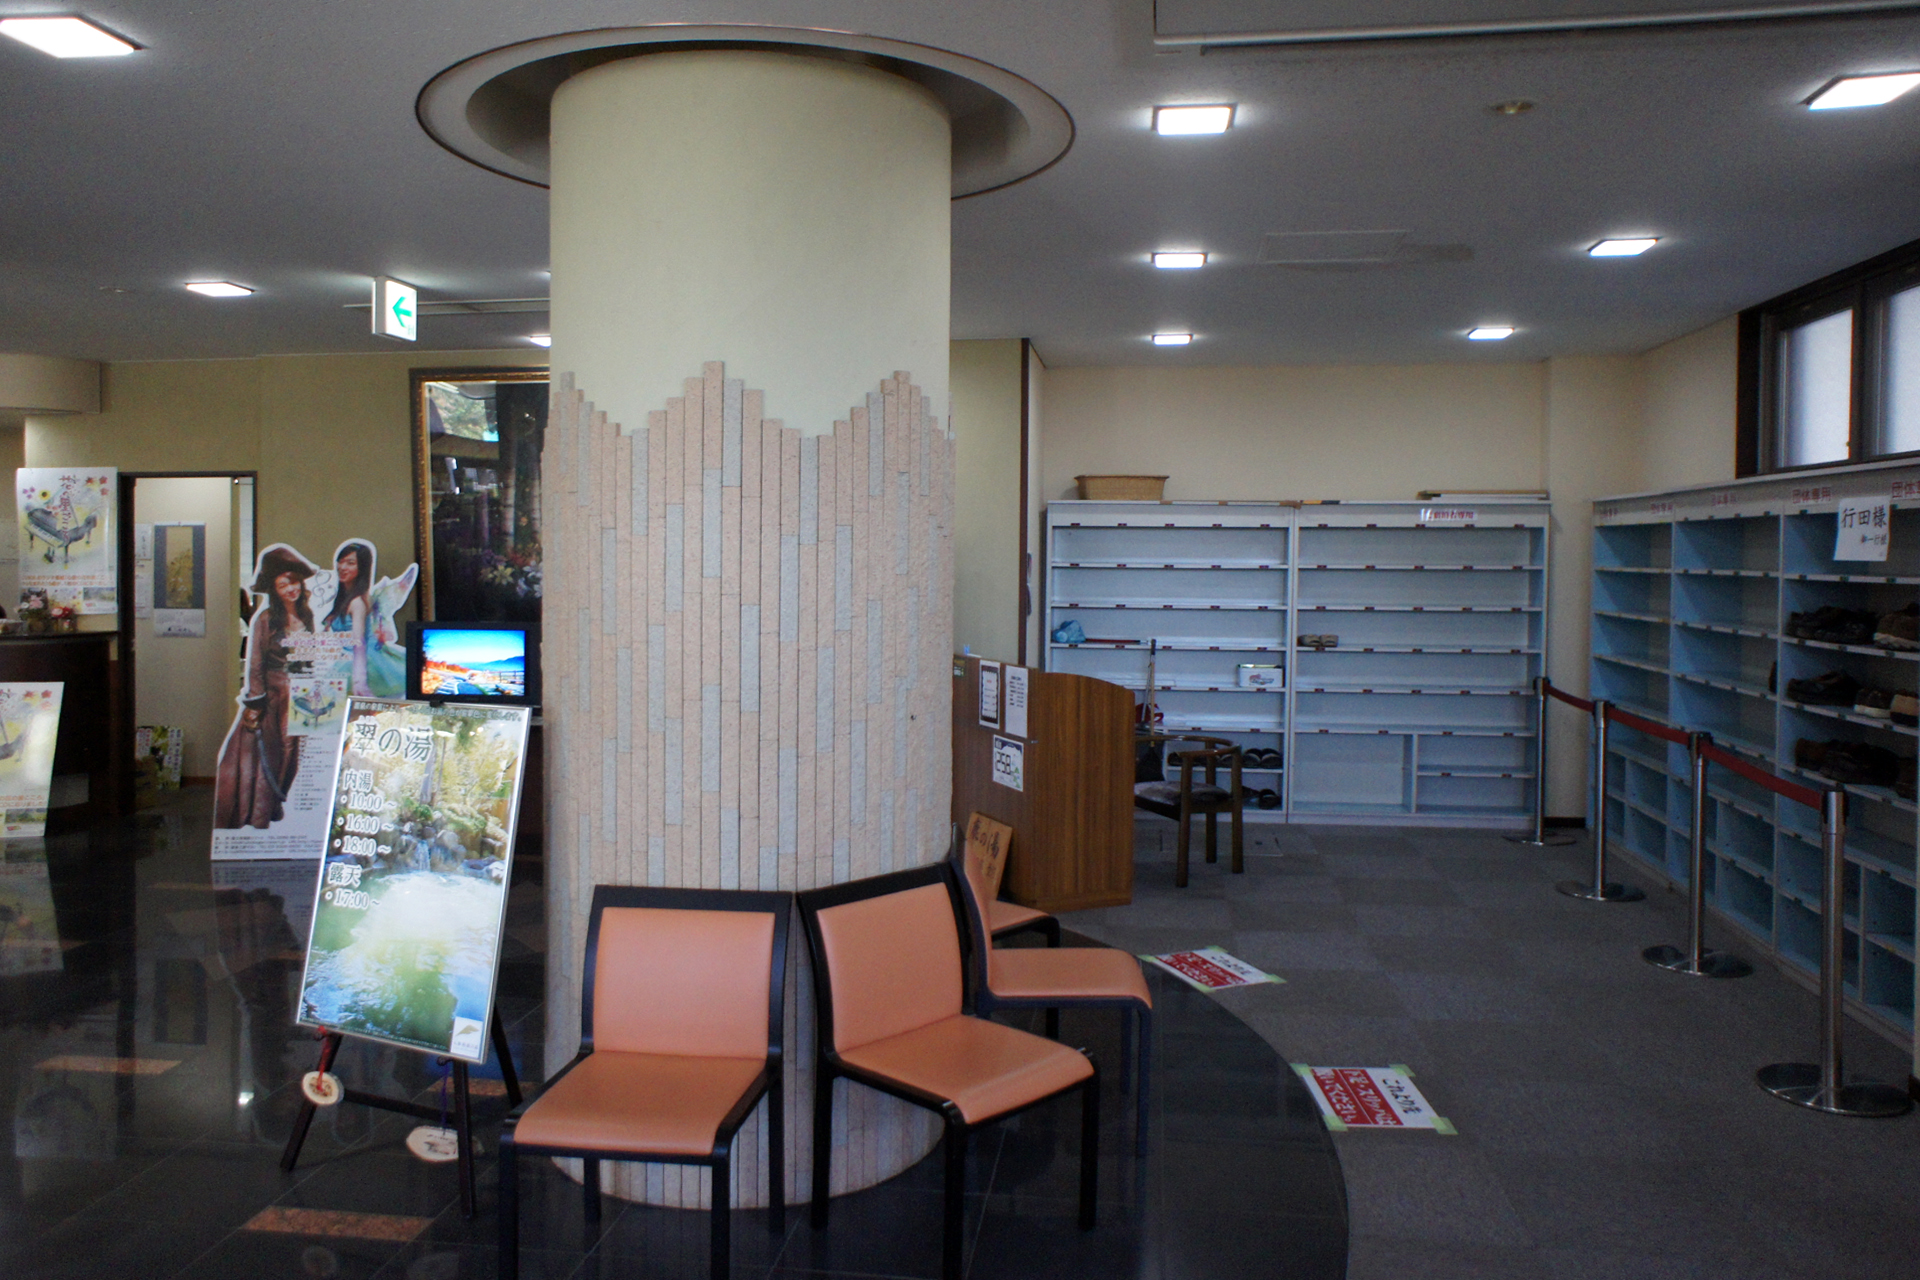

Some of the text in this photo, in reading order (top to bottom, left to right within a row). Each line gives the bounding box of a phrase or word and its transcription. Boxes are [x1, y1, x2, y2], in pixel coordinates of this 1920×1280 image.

[1841, 505, 1887, 528] 行田様
[352, 721, 432, 761] 翠の湯
[343, 770, 372, 791] 内湯
[329, 863, 361, 886] 露天
[1382, 1078, 1422, 1114] これより先
